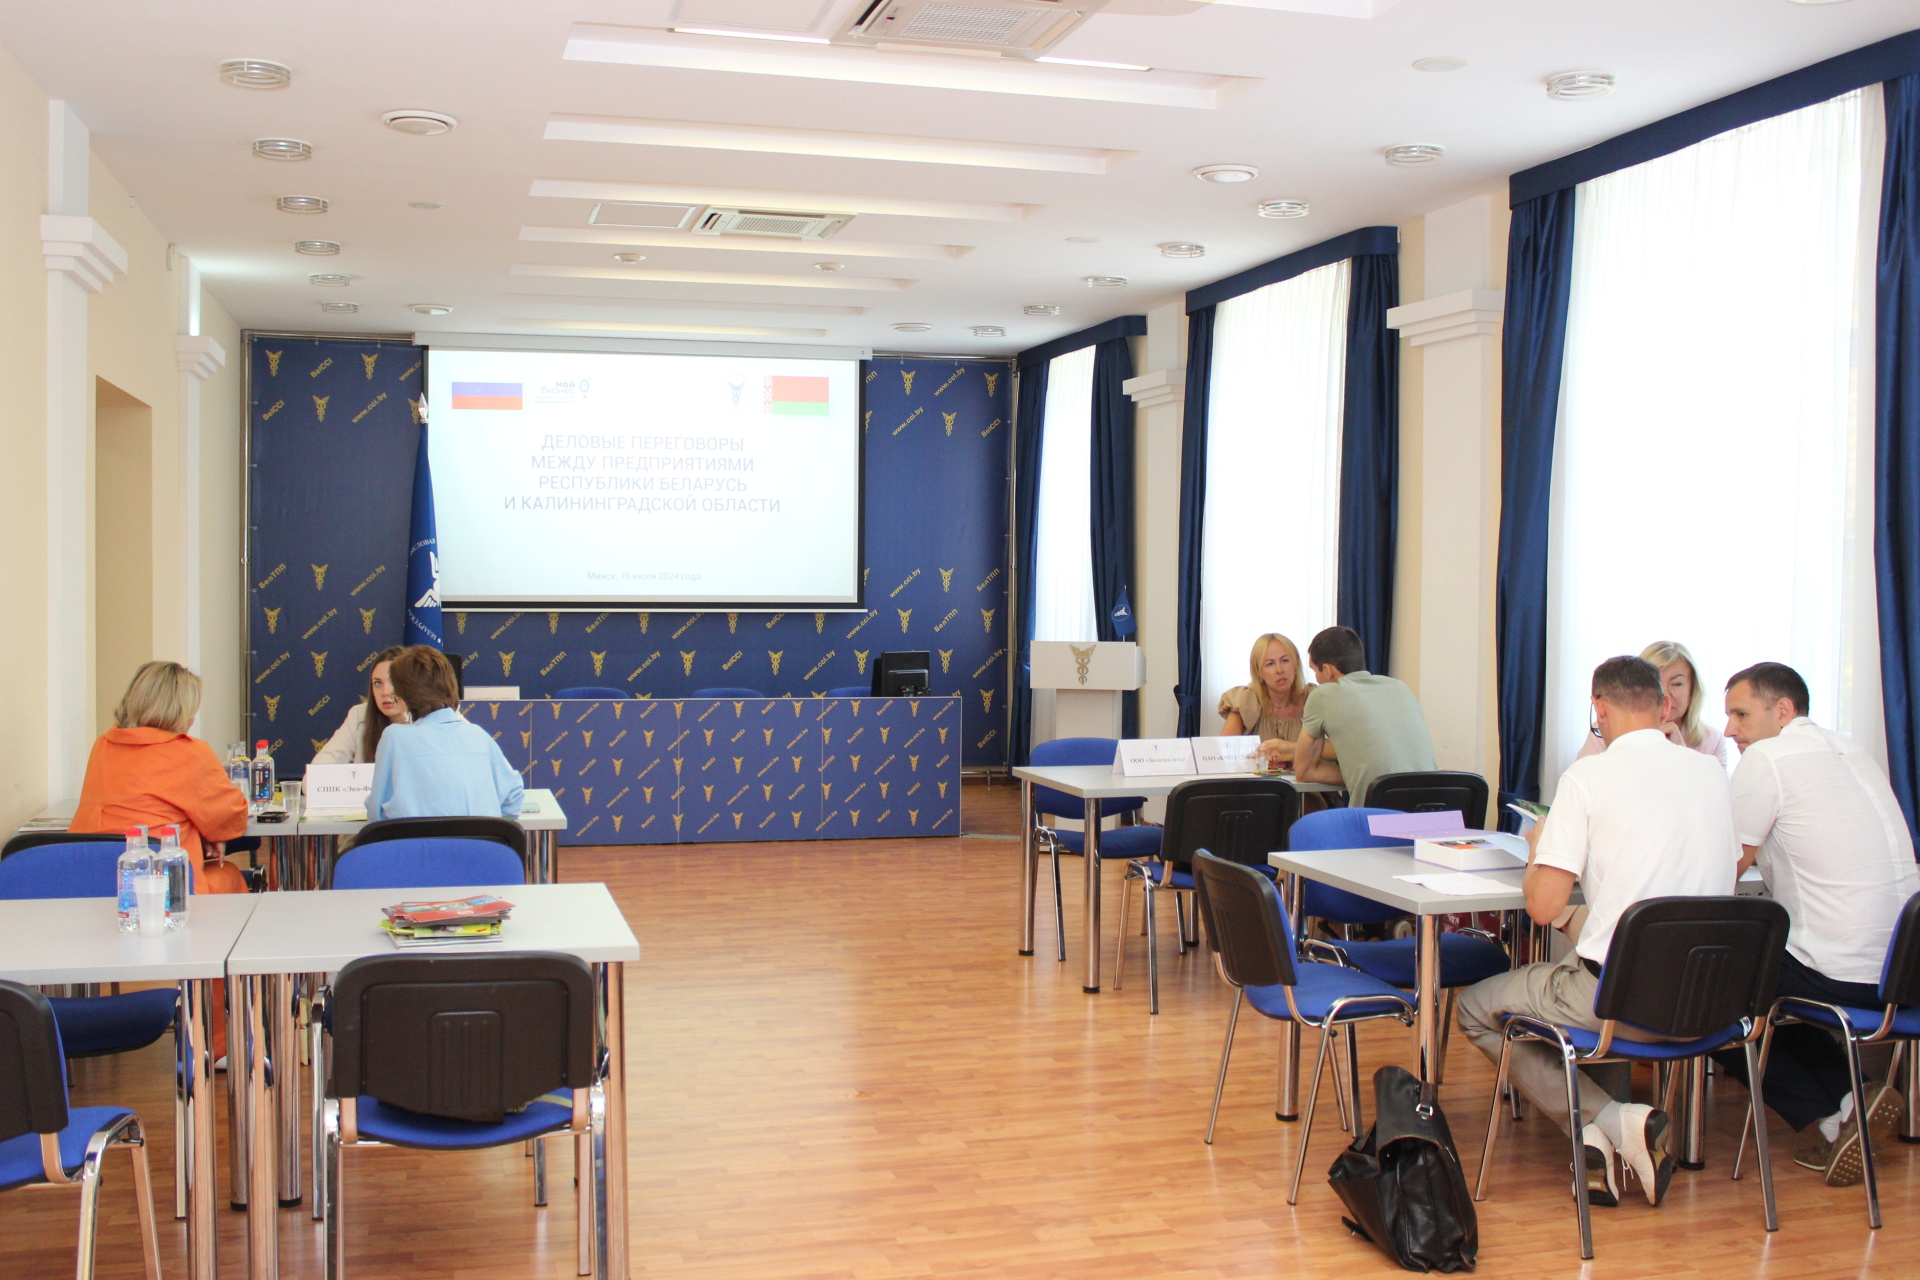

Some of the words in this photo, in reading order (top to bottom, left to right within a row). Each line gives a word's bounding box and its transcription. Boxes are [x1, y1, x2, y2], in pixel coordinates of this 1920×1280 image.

[309, 357, 333, 378] BelCCI
[933, 366, 966, 396] www.cci.by
[262, 399, 285, 421] BelCCI
[351, 392, 388, 424] www.cci.by
[891, 406, 925, 436] www.cci.by
[980, 418, 1002, 438] BelCCI
[541, 434, 627, 452] ДЕЛОВЫЕ
[631, 436, 745, 452] ПЕРЕГОВОРЫ
[531, 455, 596, 472] МЕЖДУ
[601, 456, 755, 473] ПРЕДПРИЯТИЯМИ
[538, 476, 654, 491] РЕСПУБЛИКИ
[659, 477, 748, 492] БЕЛАРУСЬ
[504, 496, 516, 510] И
[521, 495, 697, 514] КАЛИНИНГРАДСКОЙ
[701, 497, 781, 513] ОБЛАСТИ
[257, 563, 287, 589] БелТПП
[350, 564, 386, 596] www.cci.by
[586, 572, 618, 581] Минск,
[632, 573, 657, 581] июля
[658, 572, 679, 581] 2024
[681, 572, 702, 582] года
[888, 568, 922, 598] www.cci.by
[975, 567, 1000, 592] БелТПП
[301, 608, 338, 640] www.cci.by
[845, 608, 879, 639] www.cci.by
[933, 608, 959, 633] БелТПП
[255, 651, 291, 684] www.cci.by
[539, 650, 567, 676] БелТПП
[625, 650, 662, 682] www.cci.by
[721, 650, 744, 671] BelCCI
[802, 650, 837, 681] www.cci.by
[971, 648, 1003, 679] www.cci.by
[307, 695, 331, 716] BelCCI
[976, 729, 996, 749] BelCCI
